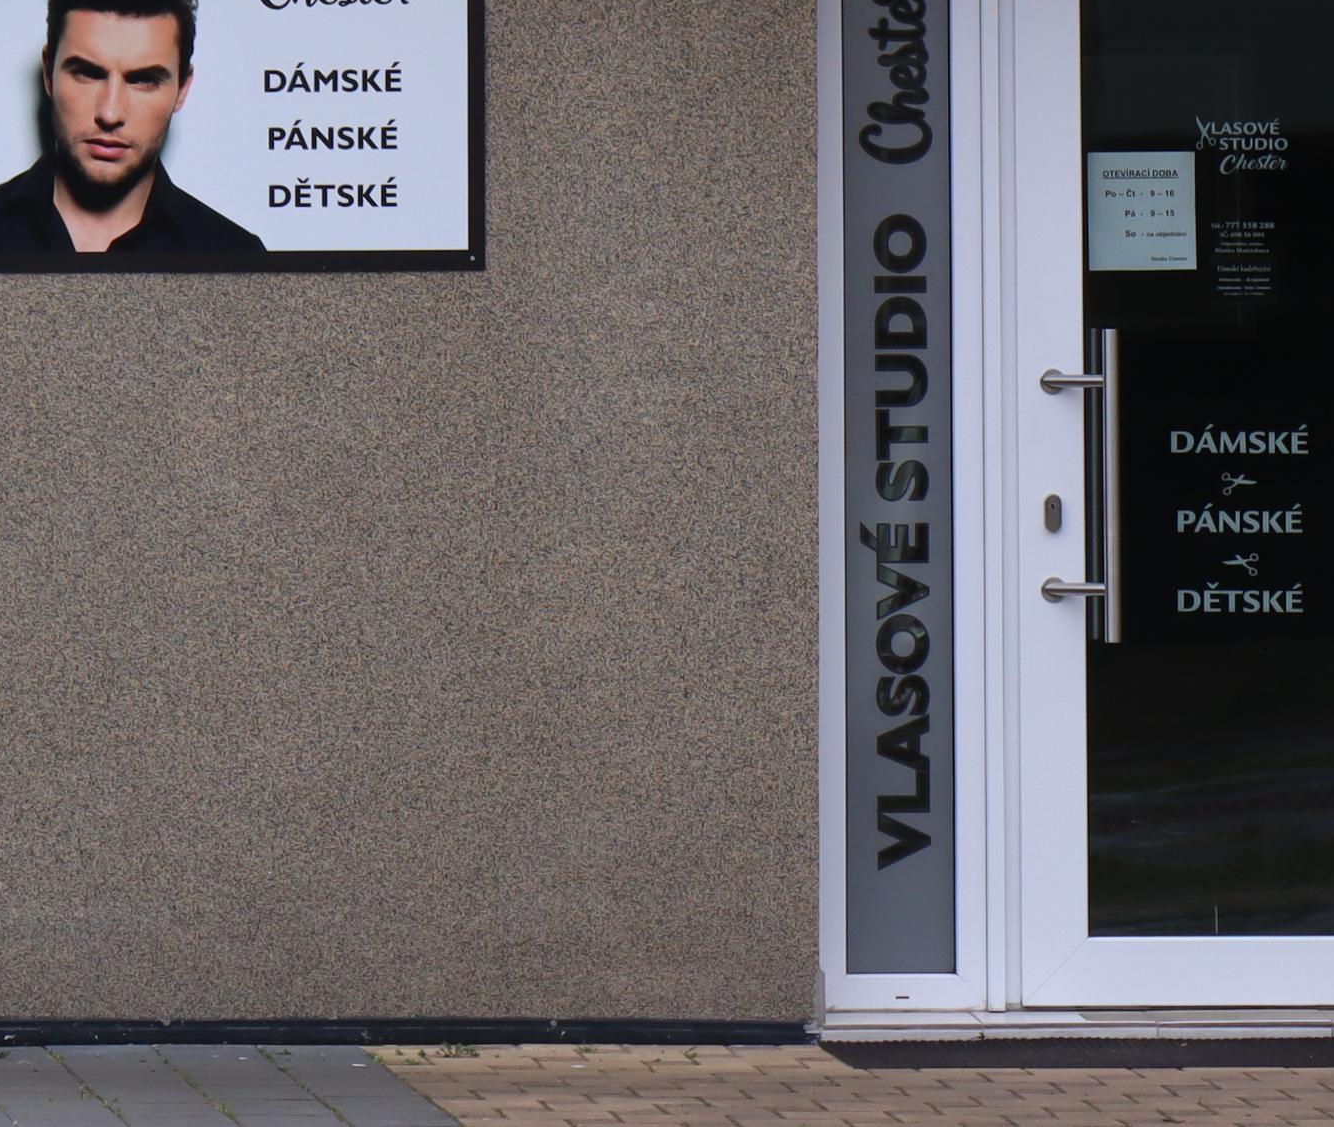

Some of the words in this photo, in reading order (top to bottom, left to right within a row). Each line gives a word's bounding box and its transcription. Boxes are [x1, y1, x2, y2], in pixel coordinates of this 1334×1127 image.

[264, 61, 402, 93] DÁMSKÉ
[268, 119, 398, 150] PÁNSKÉ
[1196, 117, 1280, 142] VLASOVÉ
[1219, 137, 1288, 151] STUDIO
[1152, 169, 1179, 179] DOBA
[1219, 153, 1287, 175] Chester
[268, 176, 398, 208] DĚTSKÉ
[1104, 189, 1117, 198] Po
[1149, 189, 1156, 198] 9
[1164, 189, 1175, 198] 16
[1149, 209, 1156, 218] 9
[1124, 229, 1137, 238] So
[872, 213, 930, 502] STUDIO
[1170, 423, 1309, 455] DÁMSKÉ
[1177, 502, 1303, 534] PÁNSKÉ
[1177, 581, 1304, 613] DĚTSKÉ
[859, 521, 932, 871] VLASOVÉ
